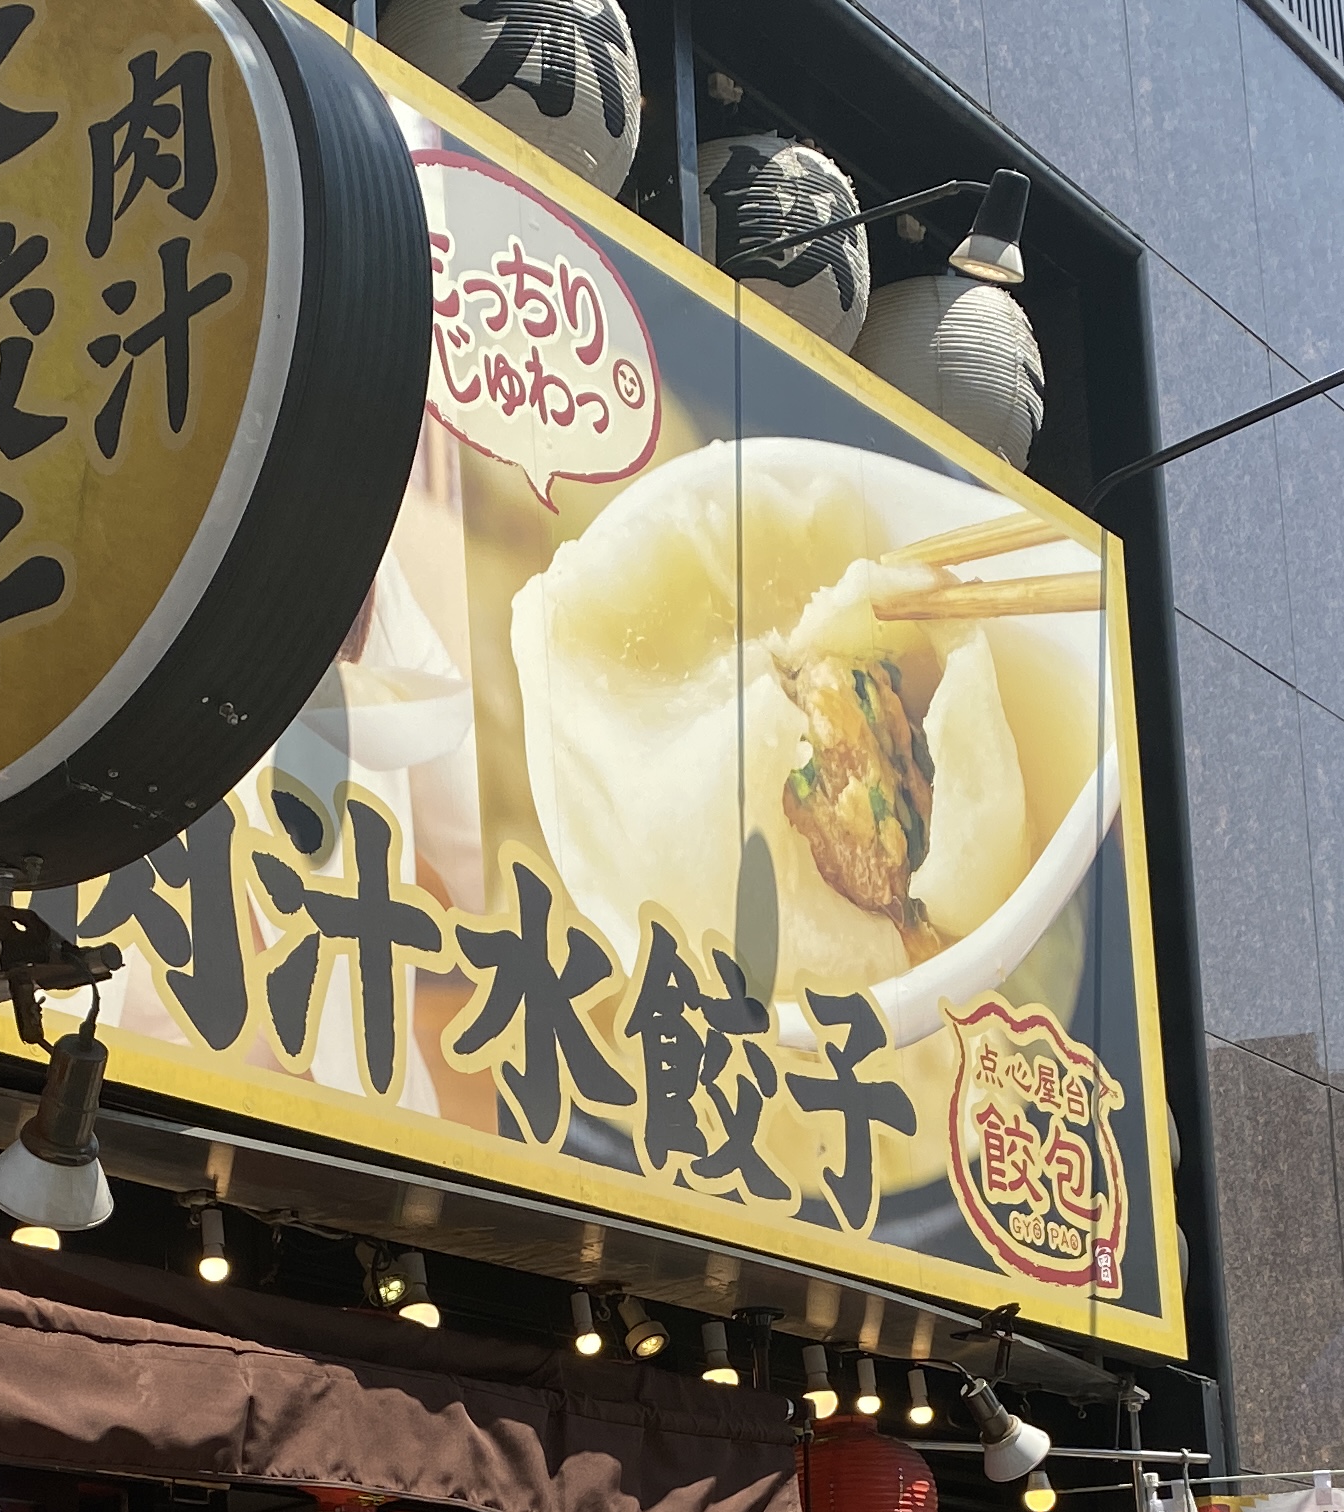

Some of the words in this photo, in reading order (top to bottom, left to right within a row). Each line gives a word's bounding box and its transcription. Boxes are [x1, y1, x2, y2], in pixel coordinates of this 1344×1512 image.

[86, 50, 233, 460] 肉汁
[434, 322, 610, 434] じゅわっ
[29, 785, 917, 1233] 肉汁水餃子
[976, 1042, 1087, 1119] 点心屋台
[976, 1102, 1102, 1221] 餃包
